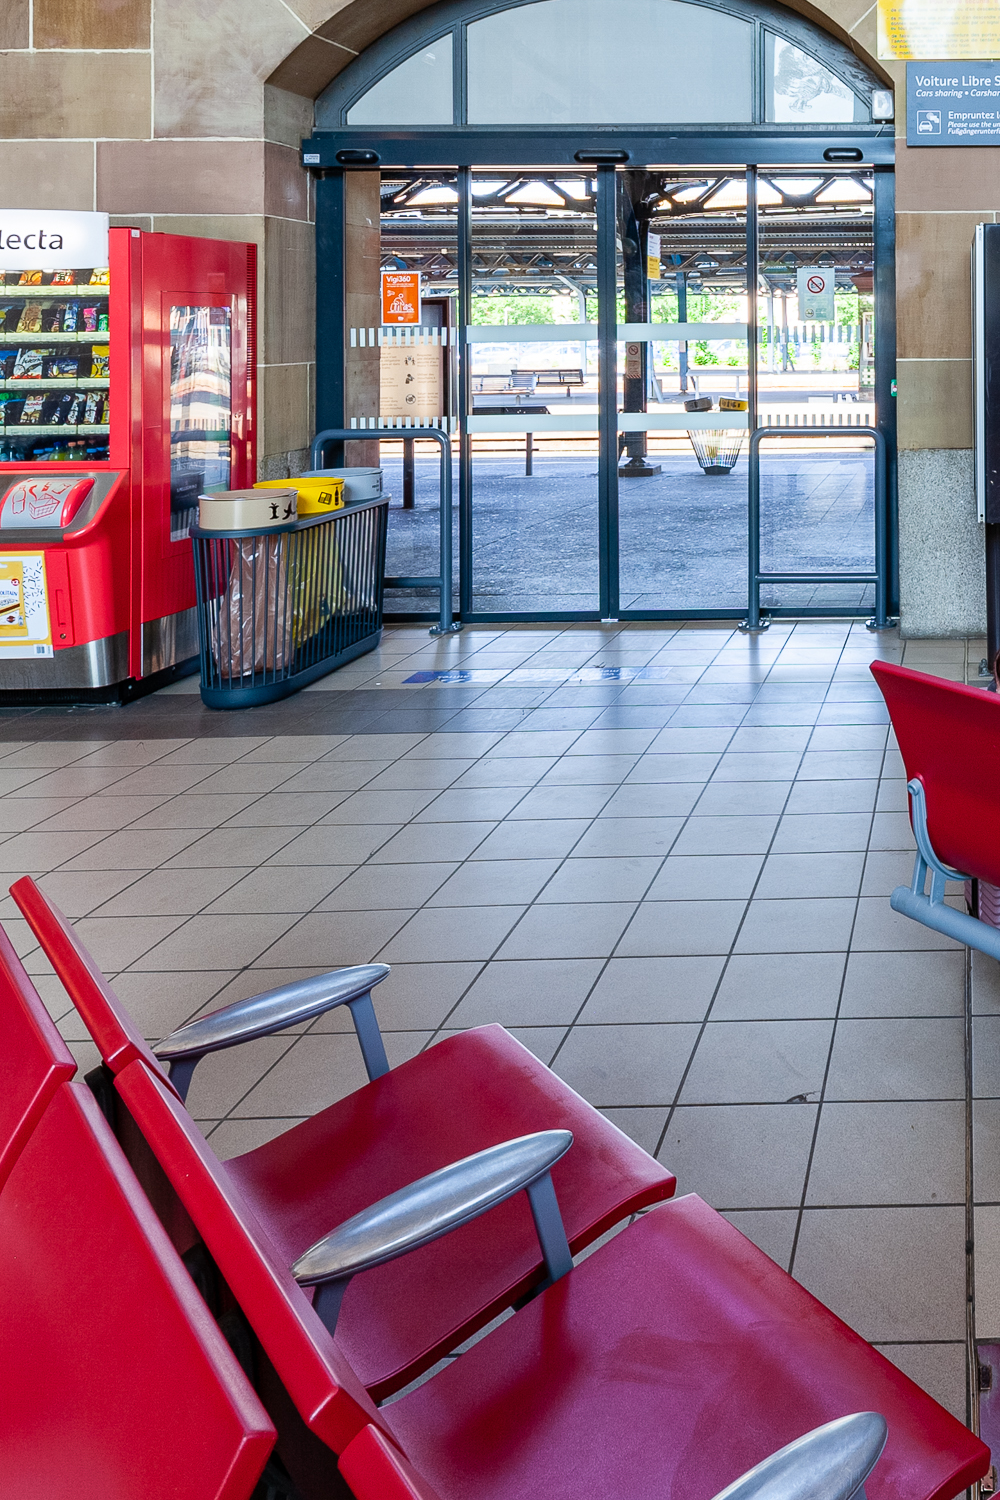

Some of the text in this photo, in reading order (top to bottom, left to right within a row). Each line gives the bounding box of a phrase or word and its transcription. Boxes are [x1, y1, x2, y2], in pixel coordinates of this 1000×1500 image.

[916, 76, 958, 86] Voiture
[962, 76, 991, 86] Libre
[916, 89, 933, 97] Cars
[935, 89, 963, 98] sharing
[948, 111, 994, 120] Empruntez
[386, 276, 411, 284] Vigi360
